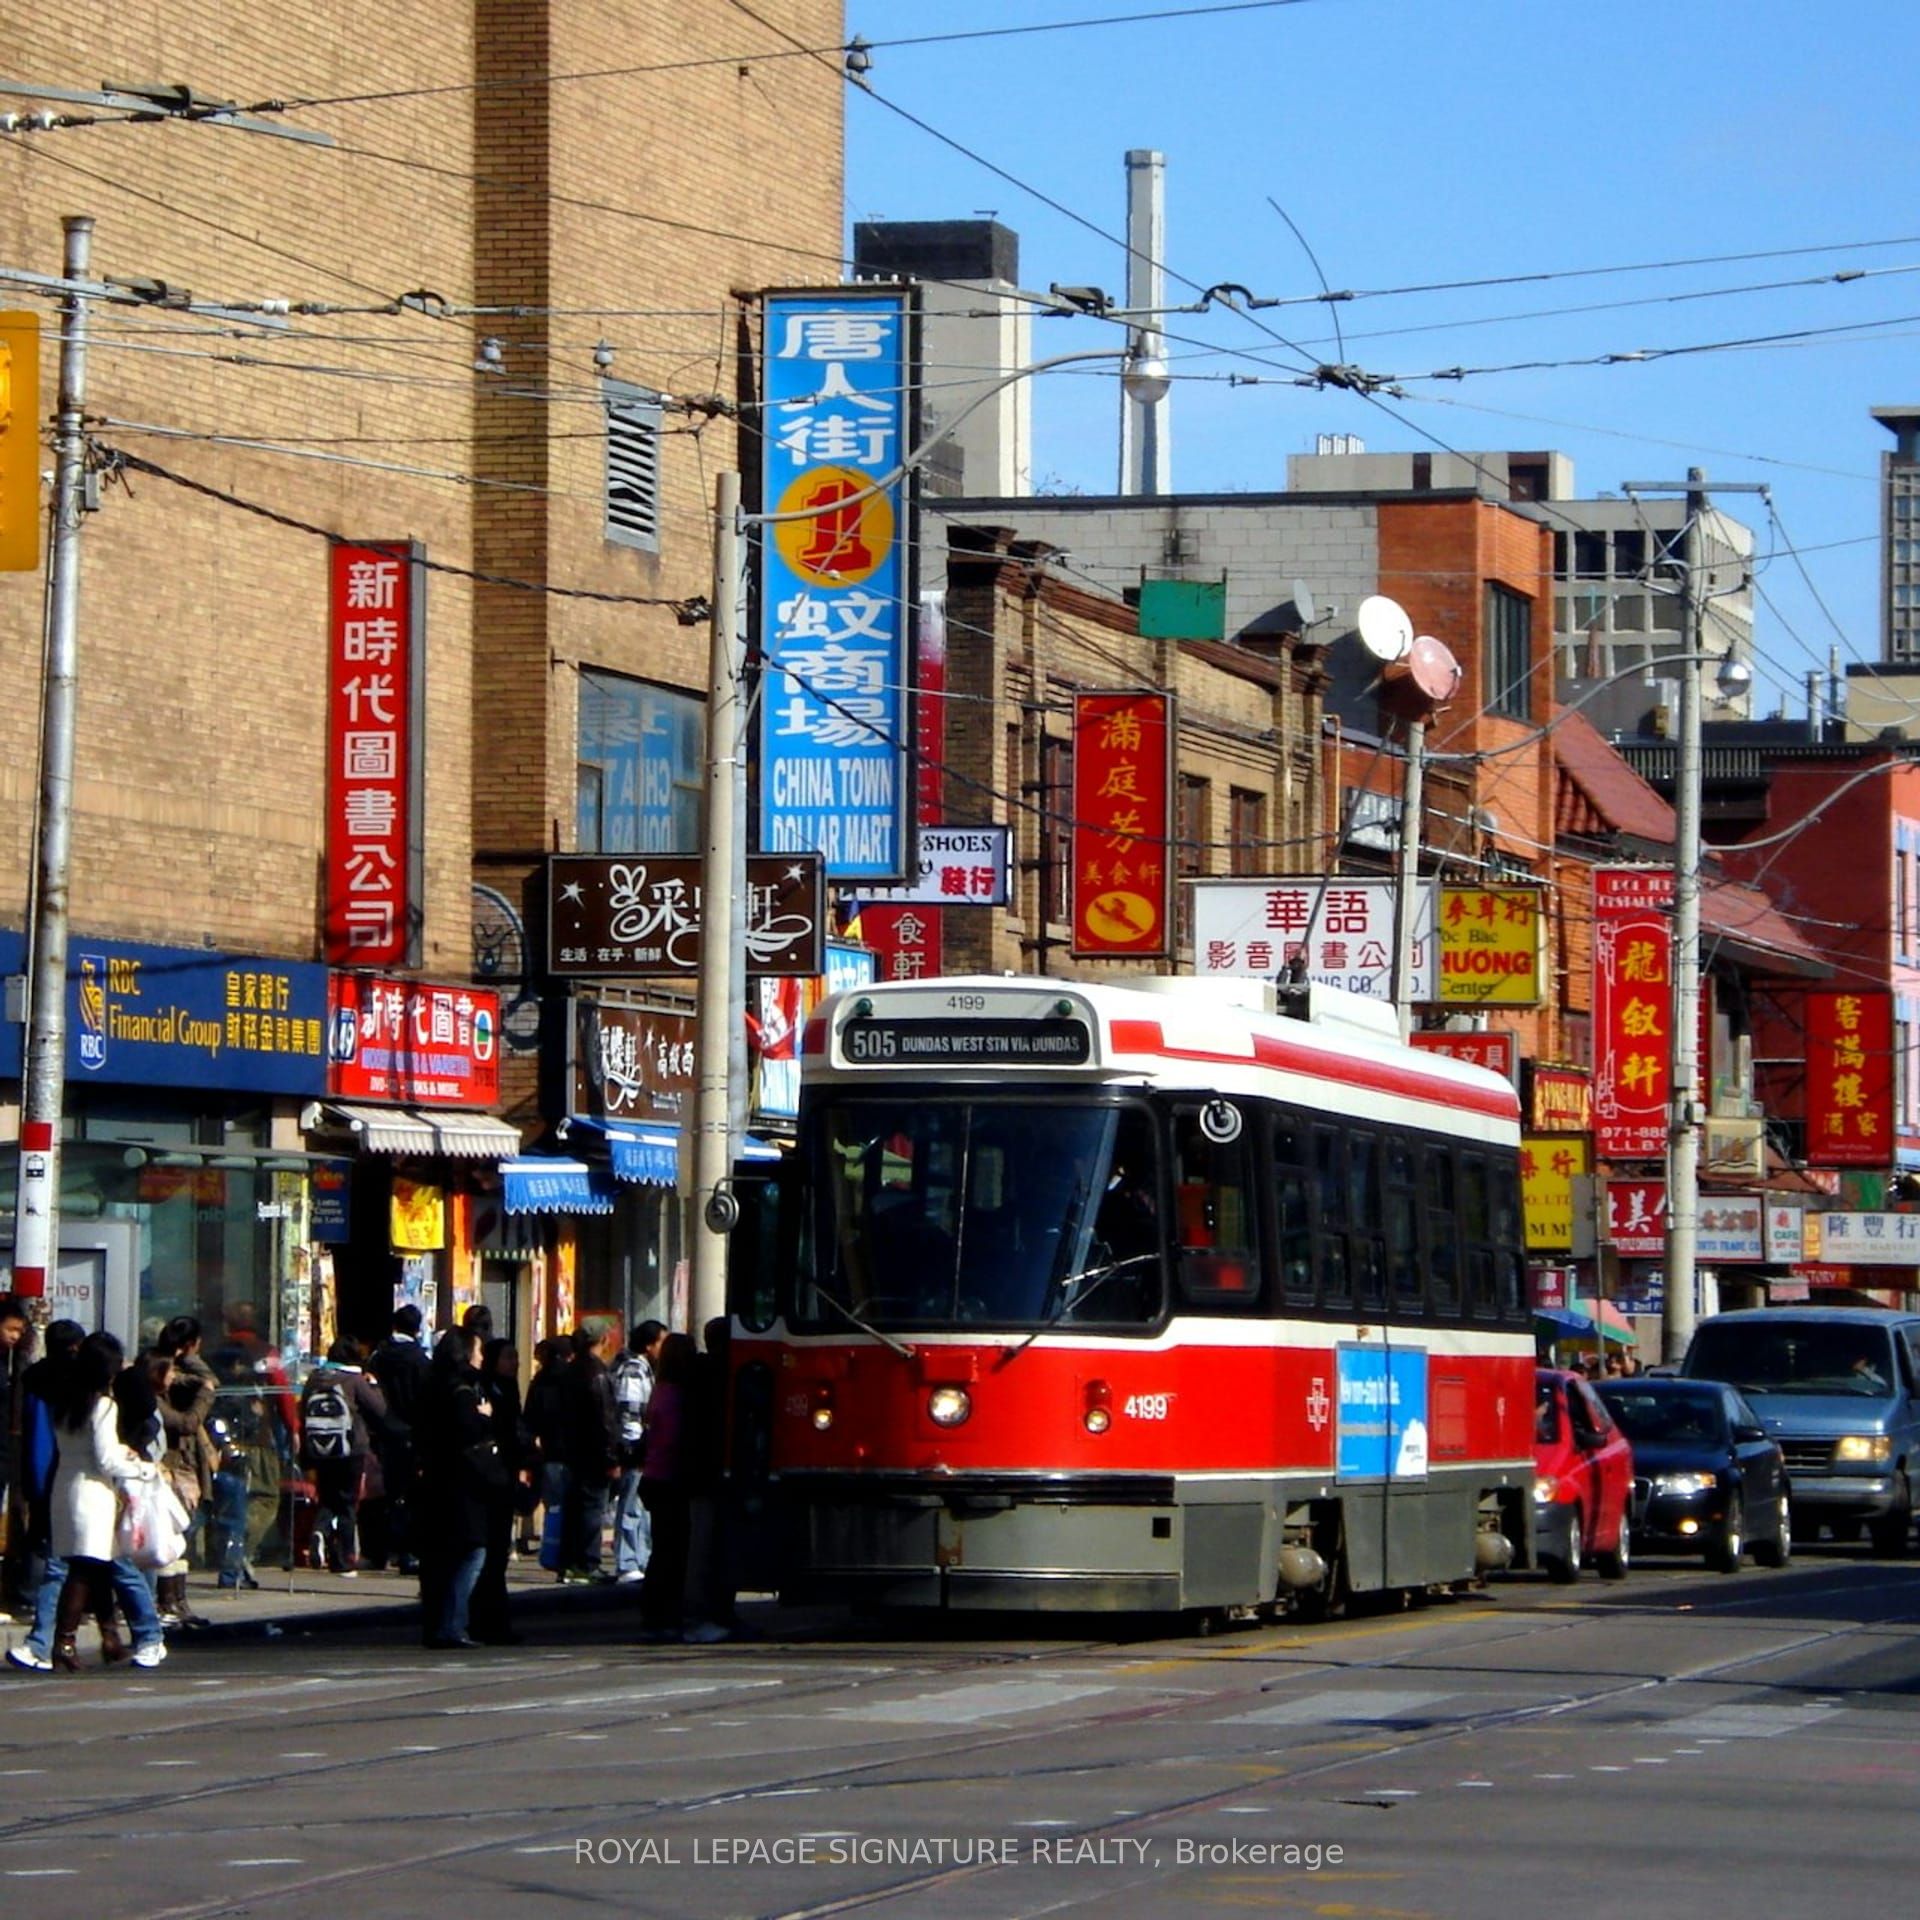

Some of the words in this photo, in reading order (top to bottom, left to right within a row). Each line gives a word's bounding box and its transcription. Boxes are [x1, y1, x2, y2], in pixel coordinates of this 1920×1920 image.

[342, 560, 400, 949] 新時代圖書公司
[773, 758, 834, 807] CHINA
[838, 758, 892, 807] TOWN
[772, 815, 840, 863] DOLLAR
[844, 815, 892, 863] MART
[923, 835, 992, 851] SHOES
[1265, 889, 1370, 934] 華語
[108, 958, 142, 996] RBC
[947, 996, 985, 1010] 4199
[80, 1035, 103, 1059] RBC
[109, 1003, 176, 1044] Financial
[178, 1010, 221, 1058] Group
[854, 1031, 896, 1058] 505
[902, 1036, 949, 1052] DUNDAS
[952, 1037, 984, 1052] WEST
[986, 1036, 1009, 1051] STN
[1011, 1036, 1030, 1051] VIA
[1032, 1035, 1080, 1051] DUNDAS
[1124, 1395, 1168, 1420] 4199
